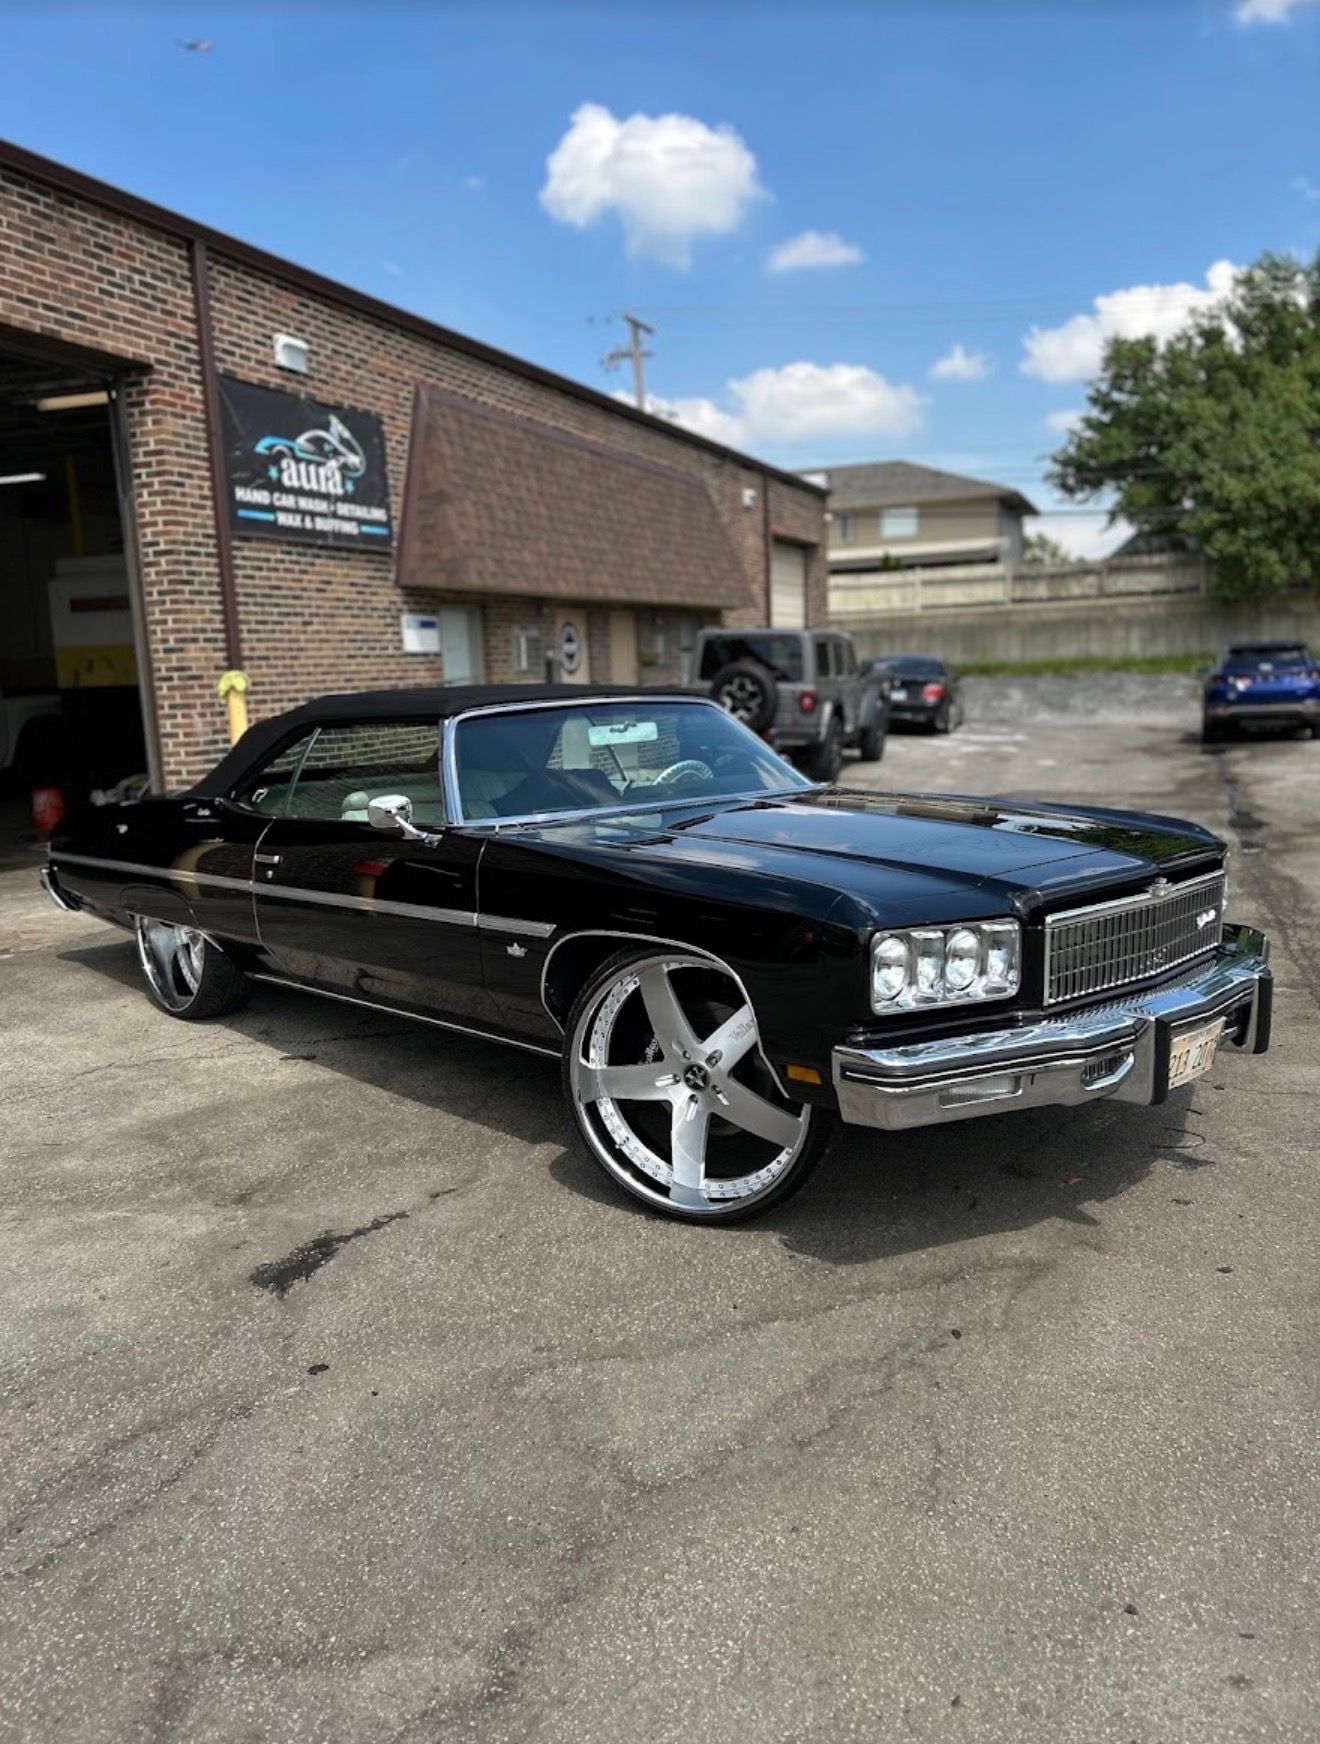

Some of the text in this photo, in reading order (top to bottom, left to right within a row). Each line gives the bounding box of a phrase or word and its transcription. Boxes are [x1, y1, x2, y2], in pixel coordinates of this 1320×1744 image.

[281, 458, 343, 494] aura
[235, 486, 271, 504] HAND
[272, 491, 297, 509] CAR
[297, 495, 330, 514] WASH
